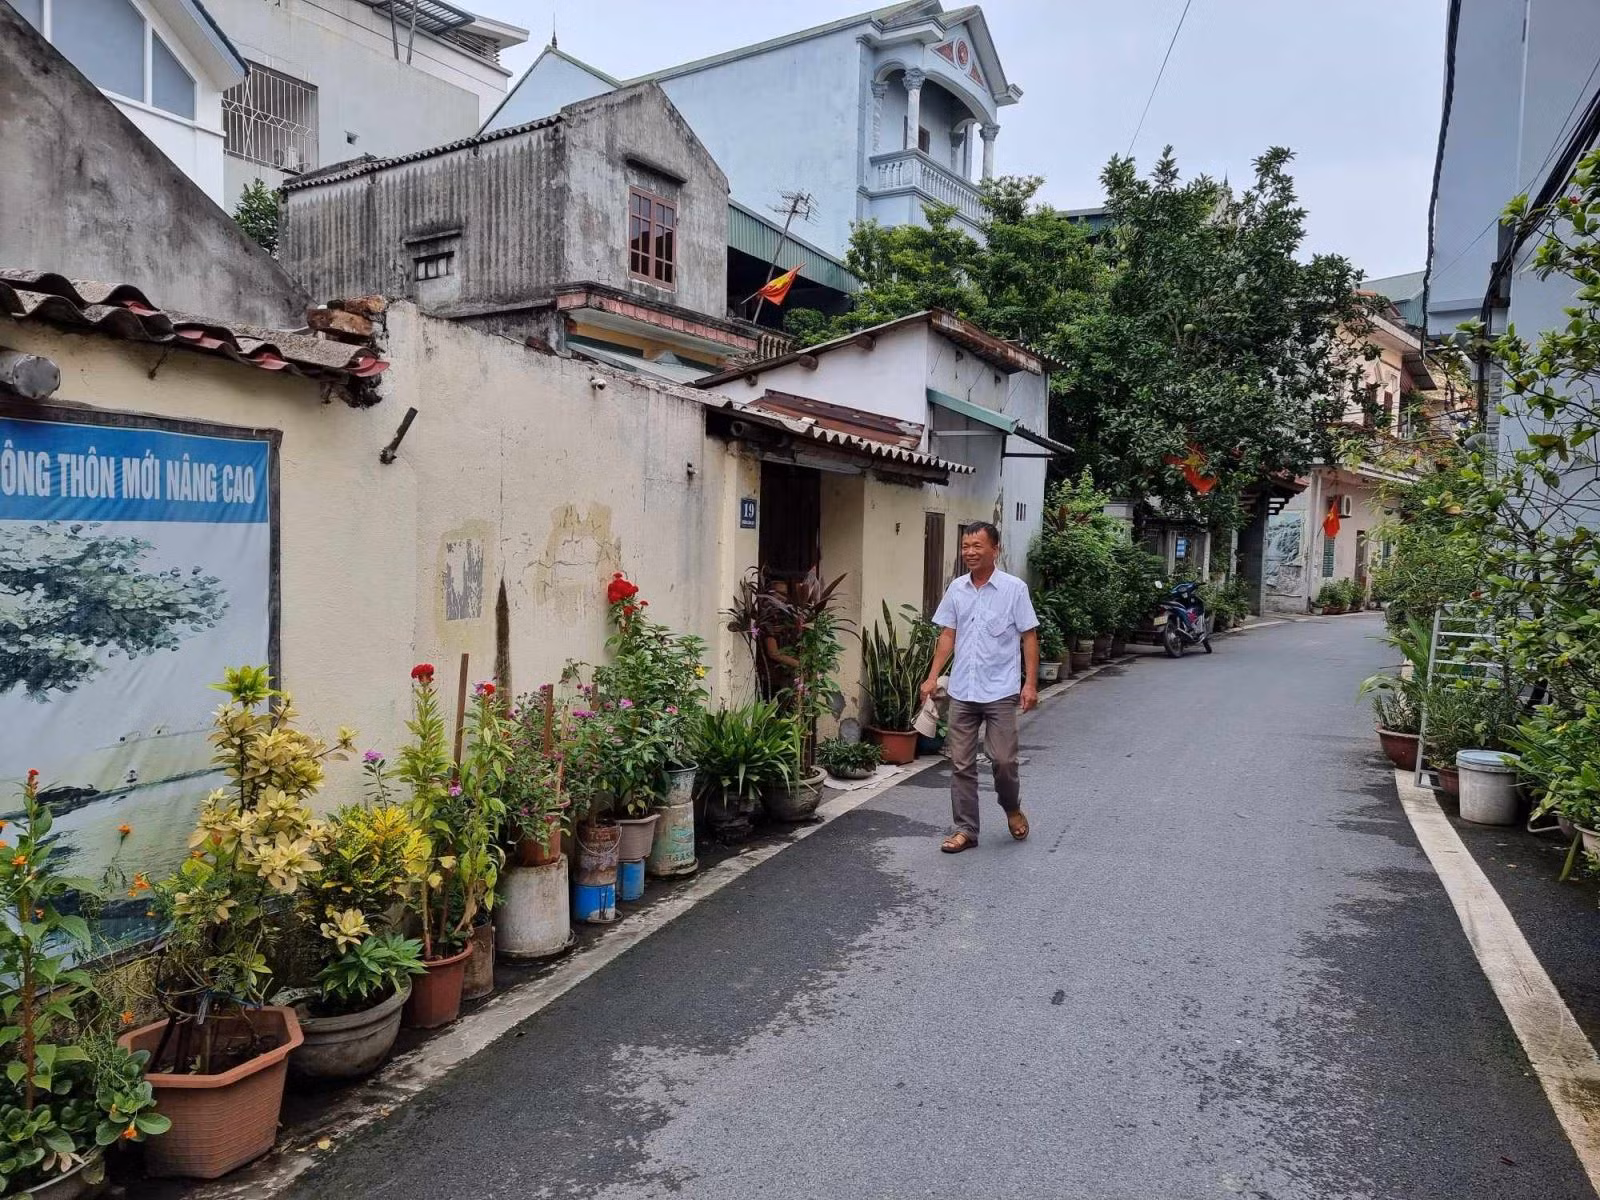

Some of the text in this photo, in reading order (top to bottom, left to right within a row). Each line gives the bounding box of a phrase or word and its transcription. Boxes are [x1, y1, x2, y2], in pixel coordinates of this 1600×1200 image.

[1, 440, 255, 504] ÔNG THÔN MỚI NÂNG CAO
[744, 503, 755, 518] 19
